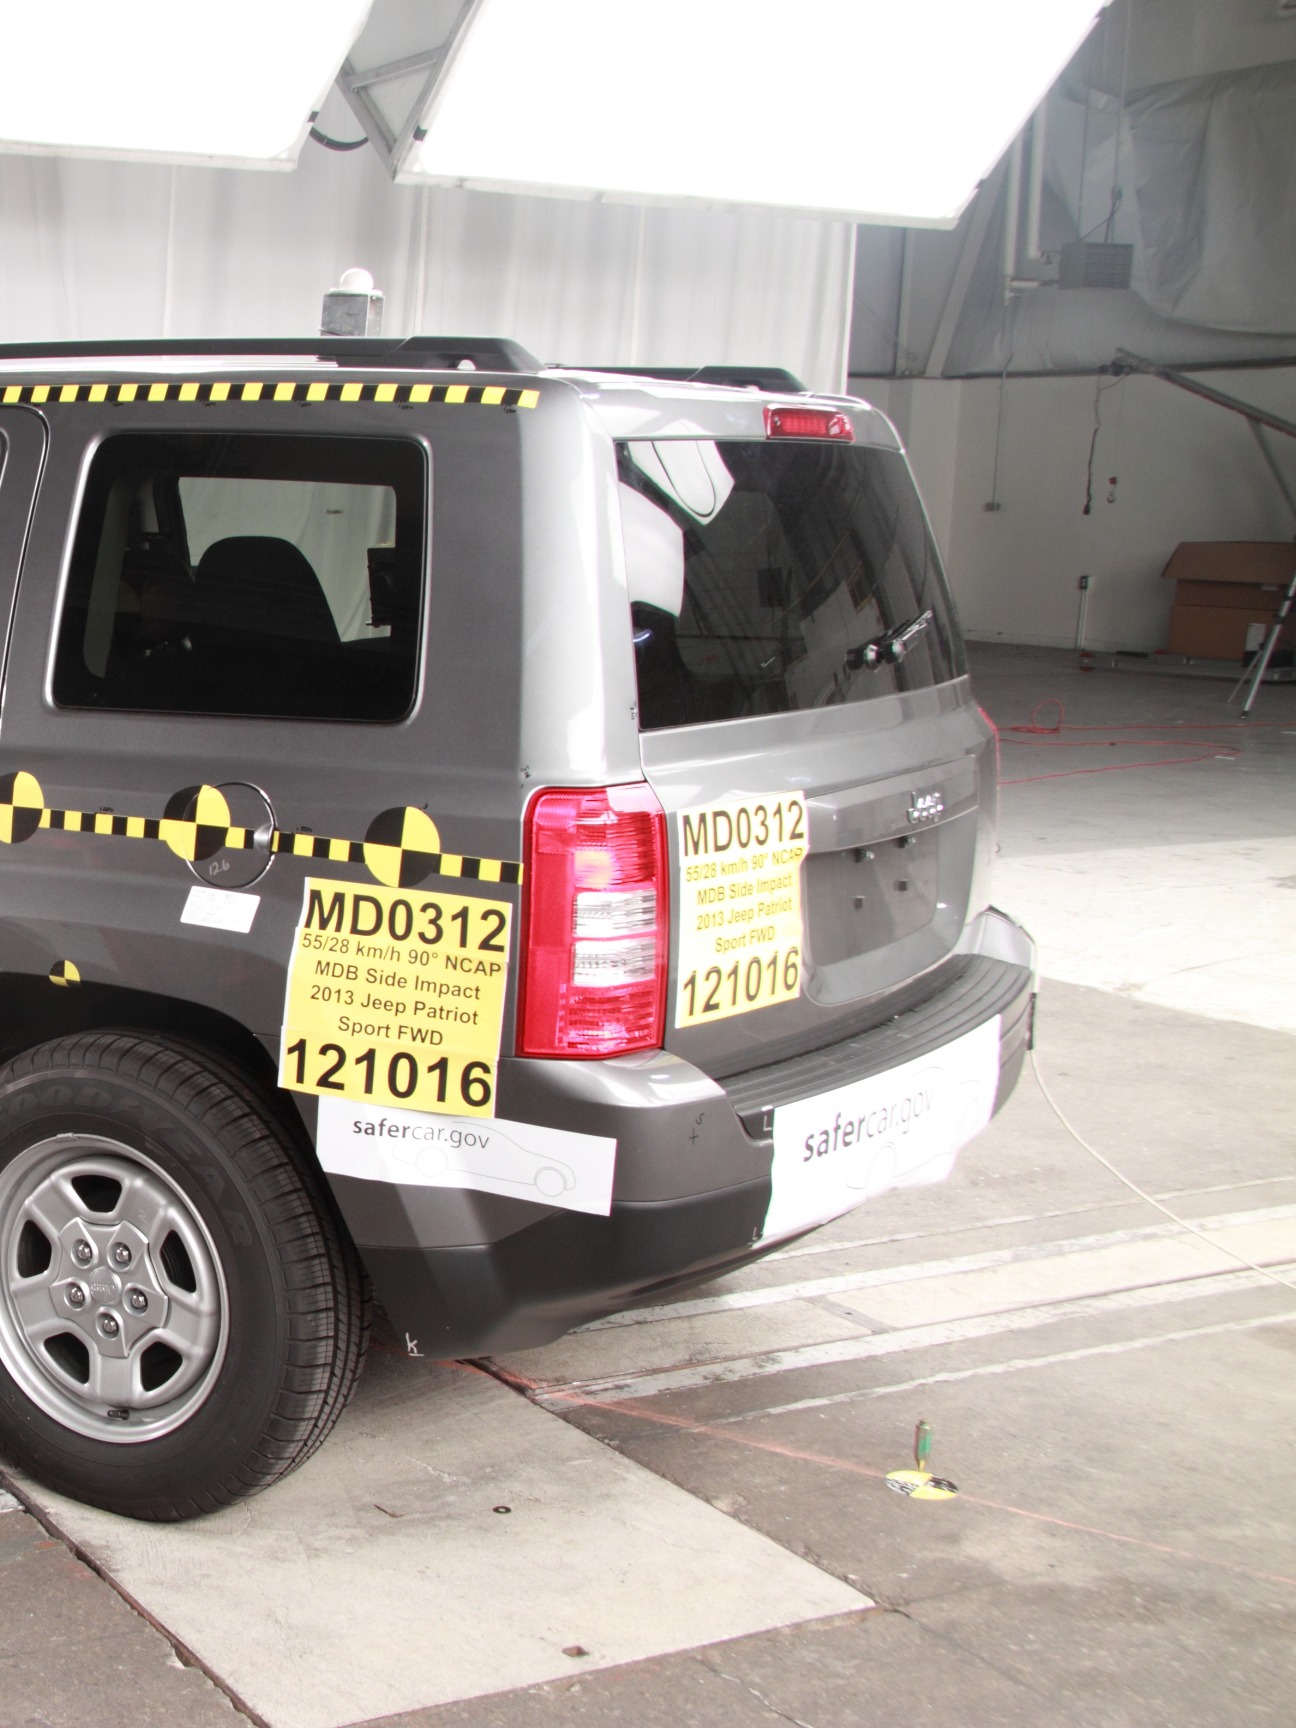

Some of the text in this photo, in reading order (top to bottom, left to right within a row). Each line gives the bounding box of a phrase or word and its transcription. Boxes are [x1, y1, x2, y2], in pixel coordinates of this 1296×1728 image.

[682, 799, 804, 857] MD0312
[209, 860, 230, 876] 12.6
[685, 862, 717, 883] 55/28
[720, 856, 748, 877] km/h
[772, 847, 803, 865] NCAP
[696, 874, 792, 905] MDB Side Impact
[304, 889, 506, 952] MD0312
[696, 899, 792, 931] 2013 Jeep Patriot
[302, 933, 502, 977] 55/28 km/h 90° NCAP
[715, 925, 776, 954] Sport FWD
[314, 960, 481, 1000] MDB Side Impact
[683, 946, 799, 1017] 121016
[310, 984, 479, 1025] 2013 Jeep Patriot
[337, 1015, 444, 1046] Sport FWD
[287, 1038, 492, 1107] 121016
[353, 1118, 490, 1149] safercar.gov
[803, 1085, 935, 1163] safercar.gov
